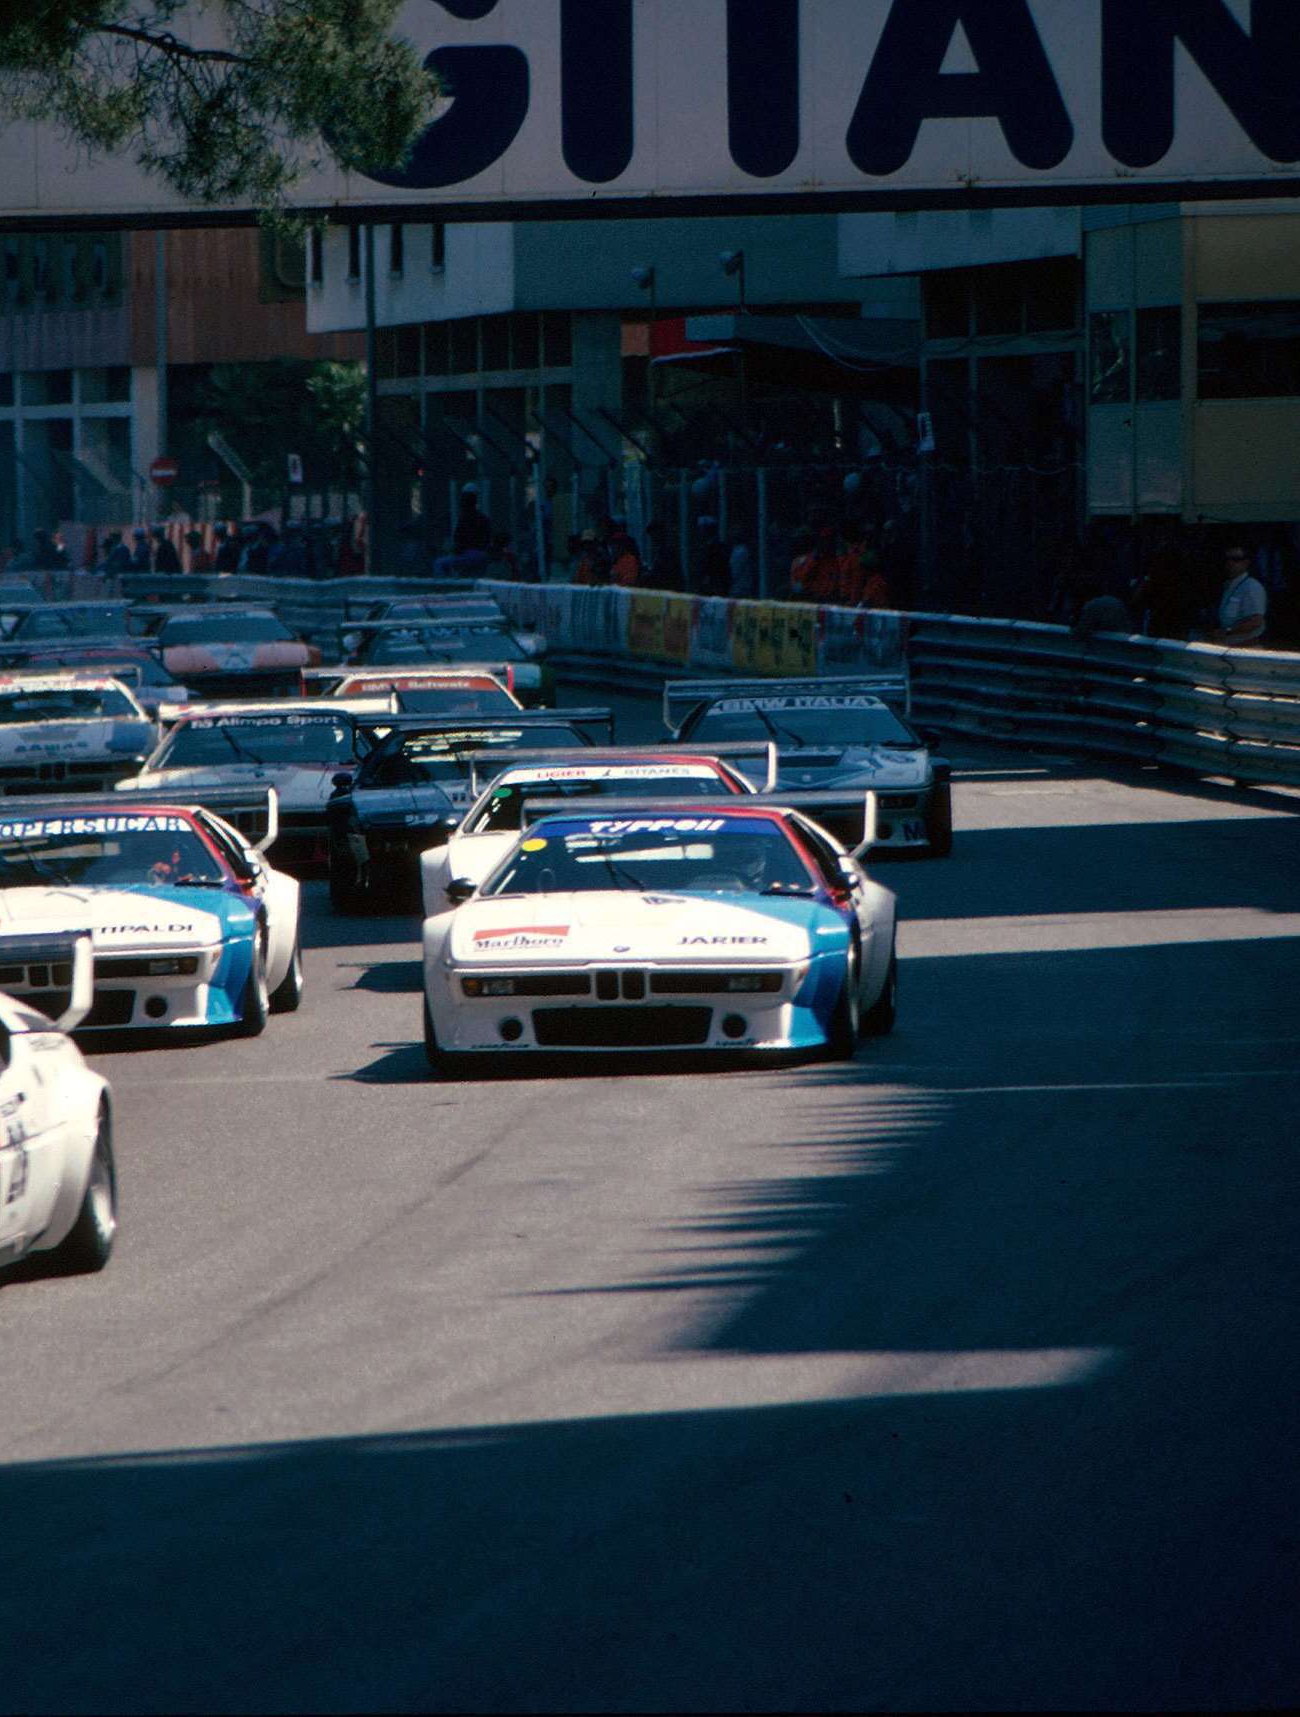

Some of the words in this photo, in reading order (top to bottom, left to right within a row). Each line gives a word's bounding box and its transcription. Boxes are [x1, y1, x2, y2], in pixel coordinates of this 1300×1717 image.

[722, 699, 786, 711] BMW
[793, 696, 870, 708] ITALIA
[285, 714, 340, 727] Sport
[536, 770, 586, 779] LIGIER
[624, 768, 688, 777] GITANES
[100, 924, 192, 934] TIPALDI
[474, 934, 564, 948] Marlboro
[677, 936, 769, 945] JARIER
